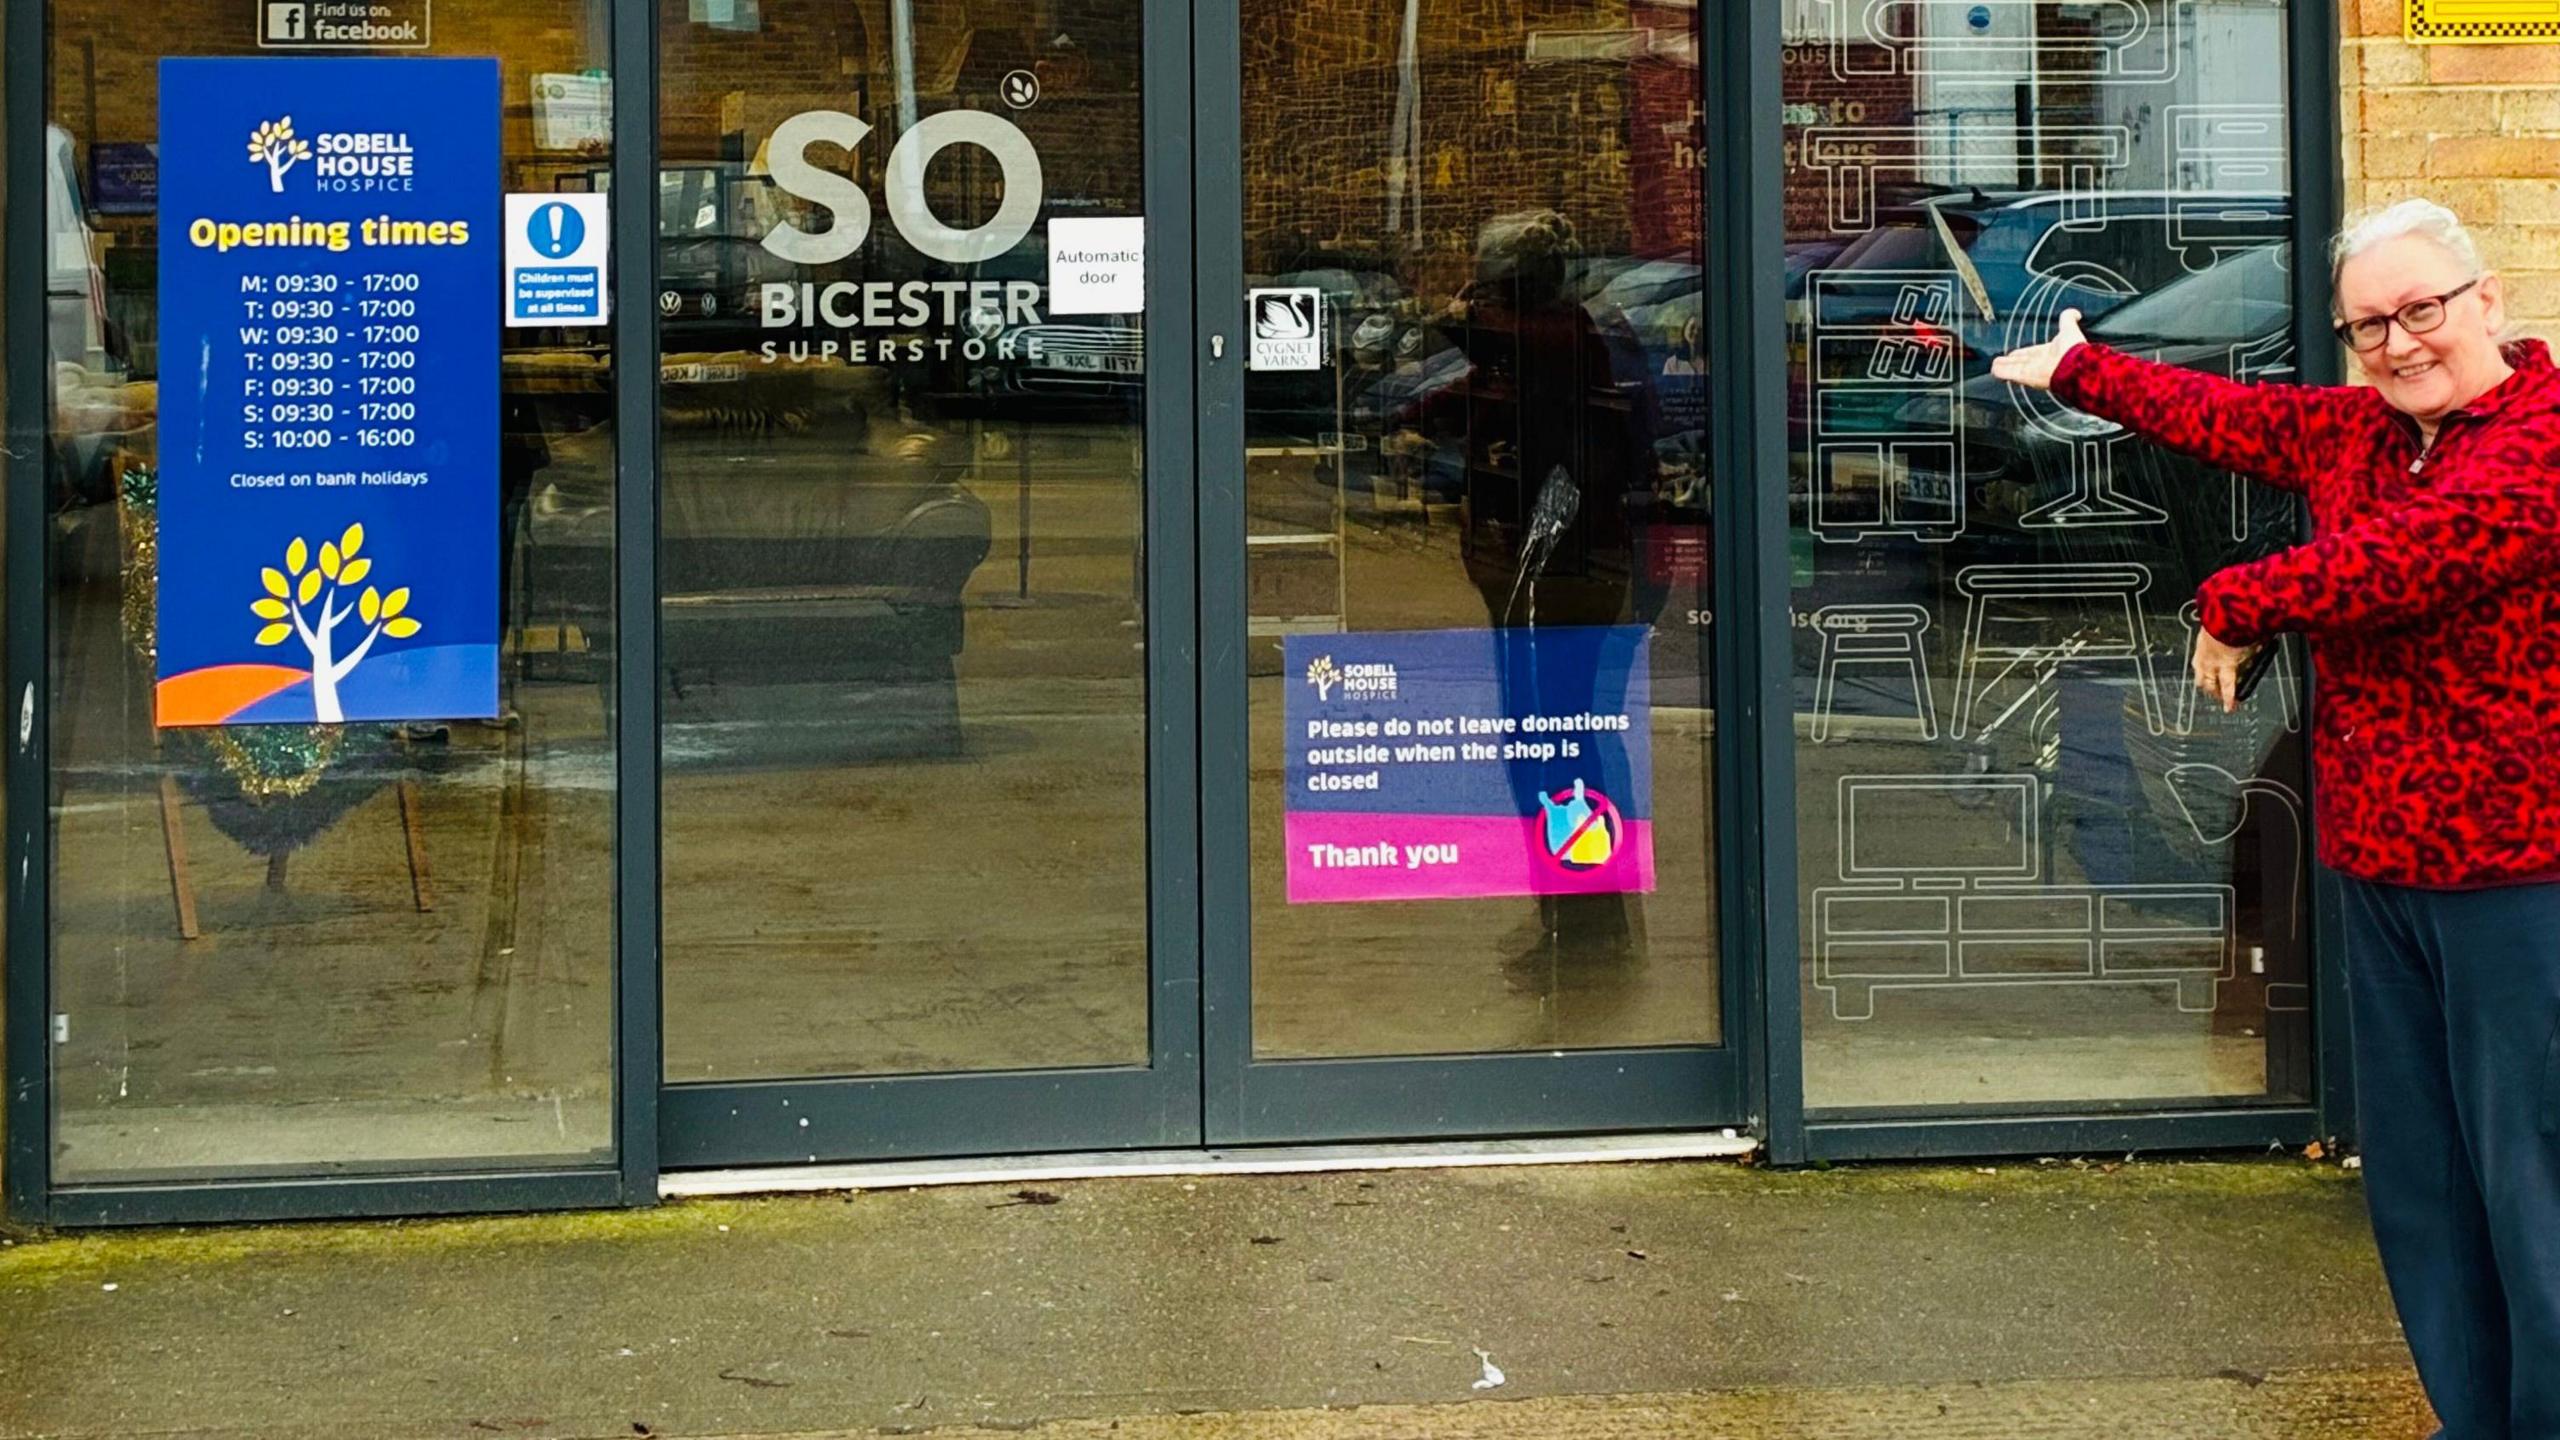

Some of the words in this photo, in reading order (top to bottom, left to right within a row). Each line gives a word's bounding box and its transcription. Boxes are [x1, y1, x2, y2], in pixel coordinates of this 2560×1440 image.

[314, 3, 345, 17] Find
[350, 5, 366, 17] us
[314, 20, 417, 40] facebook
[1829, 97, 1866, 123] to
[317, 133, 413, 153] SOBELL
[317, 156, 413, 176] HOUSE
[317, 178, 413, 192] HOSPICE
[760, 109, 1043, 264] SO
[189, 215, 350, 252] Opening
[361, 214, 469, 246] times
[1056, 250, 1139, 263] Automatic
[241, 276, 268, 293] M:
[275, 274, 338, 293] 09:30
[362, 273, 419, 291] 17:00
[519, 273, 565, 284] Children
[1080, 272, 1116, 284] door
[518, 289, 533, 299] be
[535, 288, 594, 300] supervised
[244, 301, 264, 319] T:
[271, 300, 333, 318] 09:30
[358, 299, 415, 317] 17:00
[527, 304, 538, 314] at
[556, 303, 586, 313] times
[761, 281, 1042, 328] BICESTER
[240, 327, 269, 344] W:
[276, 326, 338, 344] 09:30
[363, 325, 420, 343] 17:00
[760, 338, 1044, 364] SUPERSTORE
[1256, 342, 1313, 354] CYGNET
[244, 353, 264, 370] T:
[271, 352, 333, 370] 09:30
[358, 351, 415, 369] 17:00
[1264, 355, 1308, 366] YARNS
[244, 379, 264, 396] F:
[271, 378, 333, 396] 09:30
[358, 377, 415, 395] 17:00
[243, 404, 264, 422] S:
[271, 404, 333, 422] 09:30
[358, 403, 415, 421] 17:00
[243, 431, 264, 448] S:
[271, 430, 331, 448] 10:00
[356, 428, 415, 447] 16:00
[230, 474, 285, 487] Closed
[290, 475, 311, 486] on
[316, 472, 356, 486] bank
[361, 471, 428, 487] holidays
[1344, 664, 1397, 677] SOBELL
[1344, 678, 1397, 691] HOUSE
[1344, 691, 1397, 701] HOSPICE
[1308, 720, 1378, 738] Please
[1384, 718, 1408, 736] do
[1417, 718, 1454, 735] not
[1459, 716, 1516, 734] leave
[1521, 712, 1629, 732] donations
[1308, 745, 1389, 765] outside
[1395, 744, 1455, 762] when
[1461, 742, 1497, 760] the
[1503, 741, 1555, 762] shop
[1561, 739, 1580, 757] is
[1308, 772, 1378, 791] closed
[1308, 842, 1398, 867] Thank
[1405, 843, 1458, 869] you
